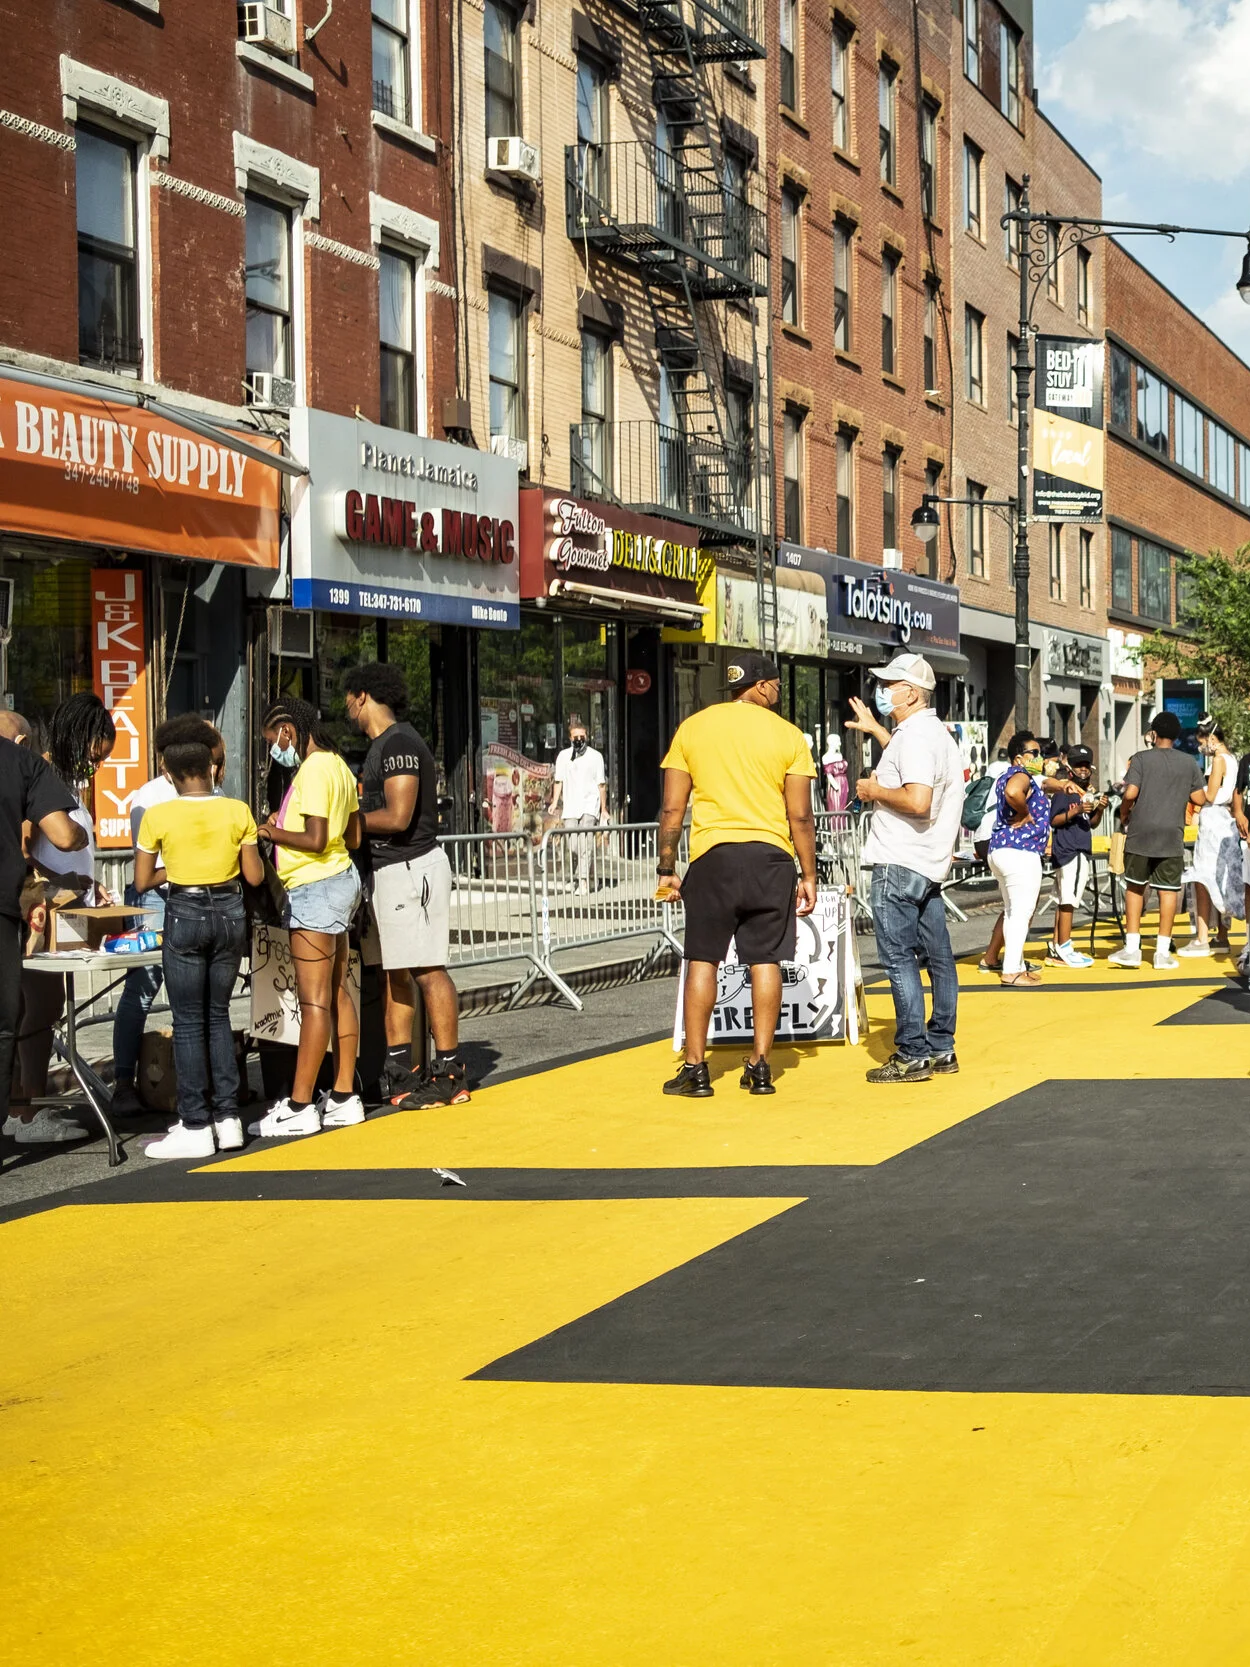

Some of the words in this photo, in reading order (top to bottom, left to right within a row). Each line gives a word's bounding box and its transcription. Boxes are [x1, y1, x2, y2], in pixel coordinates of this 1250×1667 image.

[1046, 371, 1073, 388] STUY
[15, 401, 137, 474] BEAUTY
[147, 431, 248, 498] SUPPLY
[361, 442, 415, 476] Planet
[416, 457, 478, 491] Jamaica
[345, 489, 418, 549] GAME
[420, 512, 439, 553] &
[441, 508, 515, 564] MUSIC
[558, 500, 605, 534] Fulton
[559, 537, 609, 571] Gourmet
[612, 529, 651, 572] DELI
[785, 552, 802, 566] 1407
[329, 588, 350, 605] 1399
[100, 818, 131, 838] SUPP
